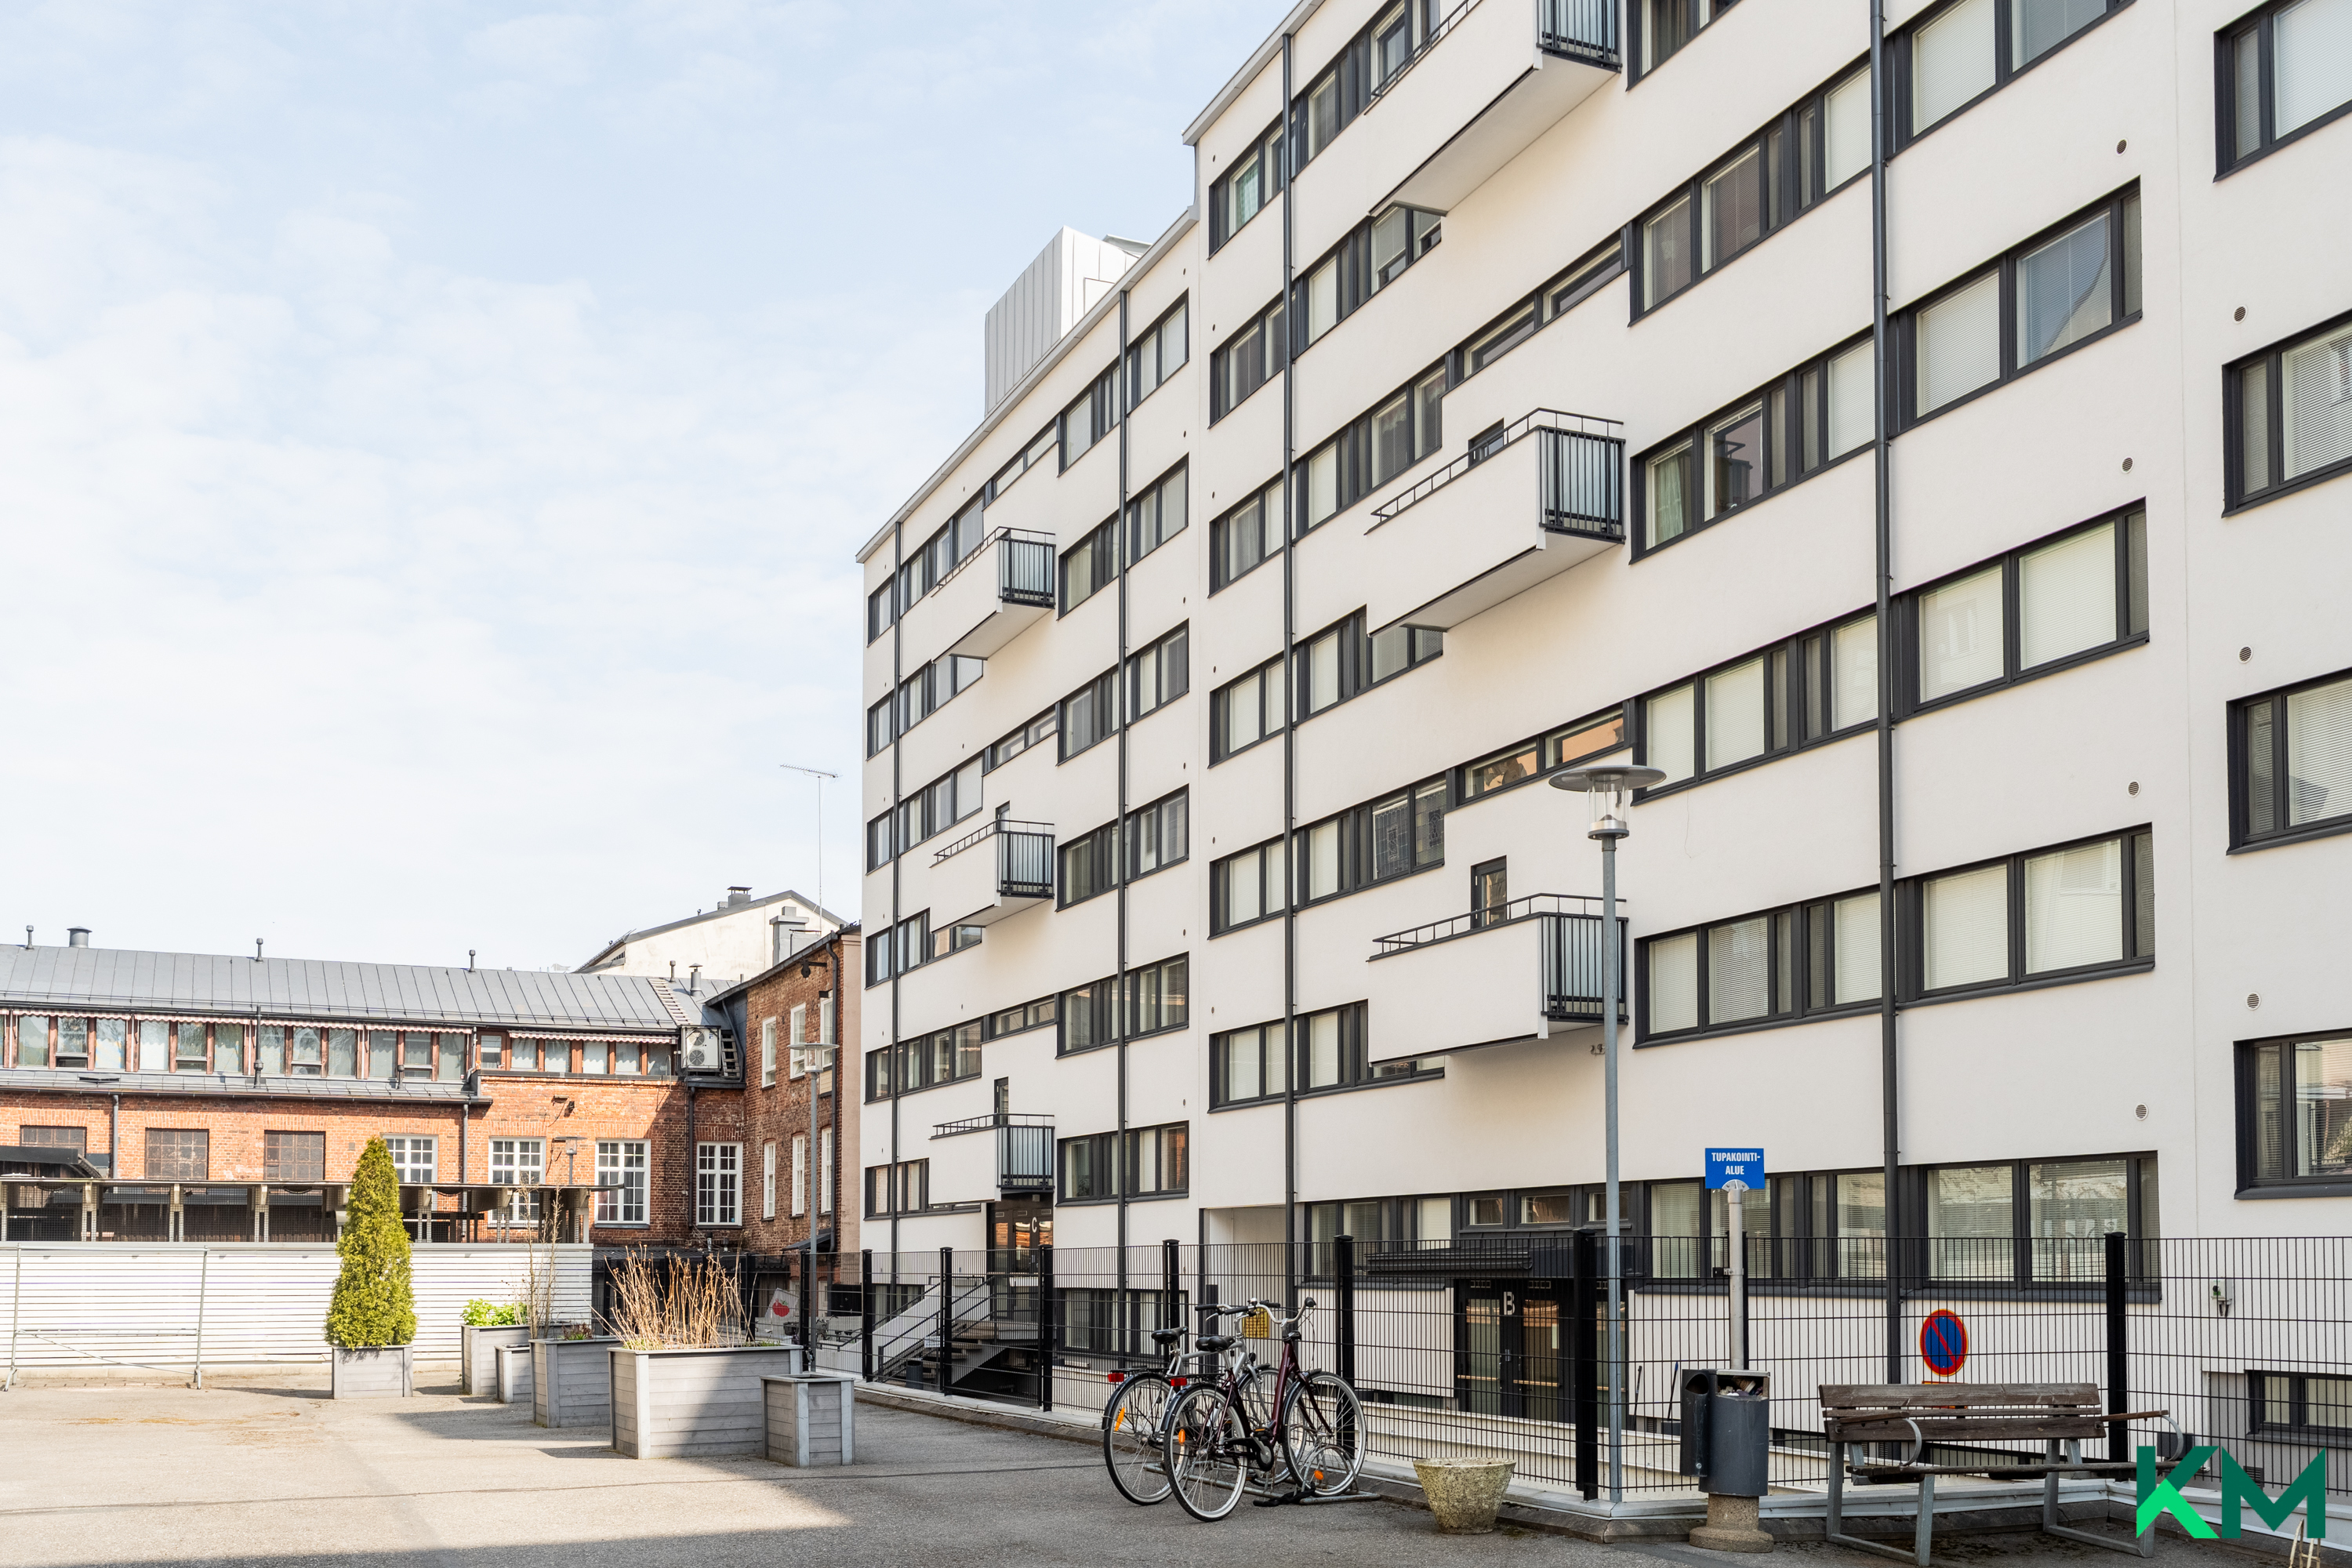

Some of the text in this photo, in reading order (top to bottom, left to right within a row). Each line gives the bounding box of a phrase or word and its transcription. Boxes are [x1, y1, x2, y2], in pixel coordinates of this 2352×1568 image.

[1711, 1152, 1761, 1162] TUPAKOINTI-
[1725, 1165, 1744, 1175] ALUE
[1032, 1217, 1037, 1232] C
[1503, 1291, 1515, 1315] B
